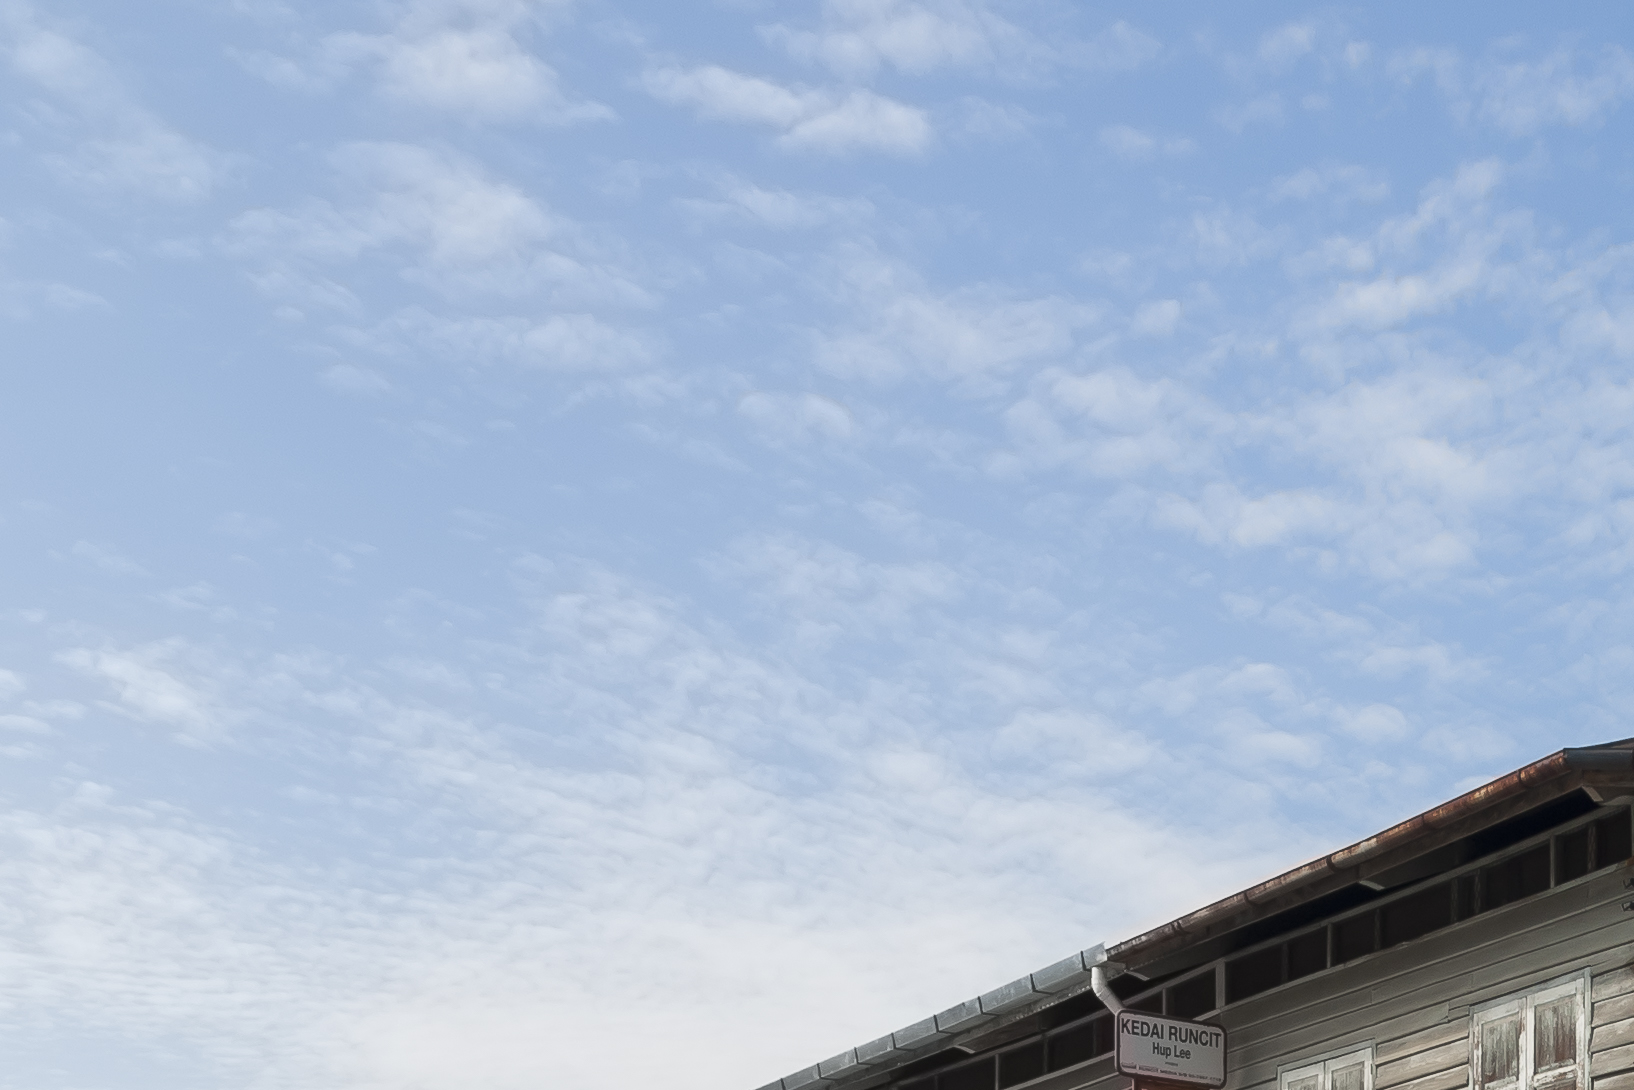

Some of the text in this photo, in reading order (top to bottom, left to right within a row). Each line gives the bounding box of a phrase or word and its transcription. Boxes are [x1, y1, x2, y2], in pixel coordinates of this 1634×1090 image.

[1121, 1018, 1222, 1048] KEDAI RUNCIT
[1152, 1042, 1191, 1060] Hup Lee
